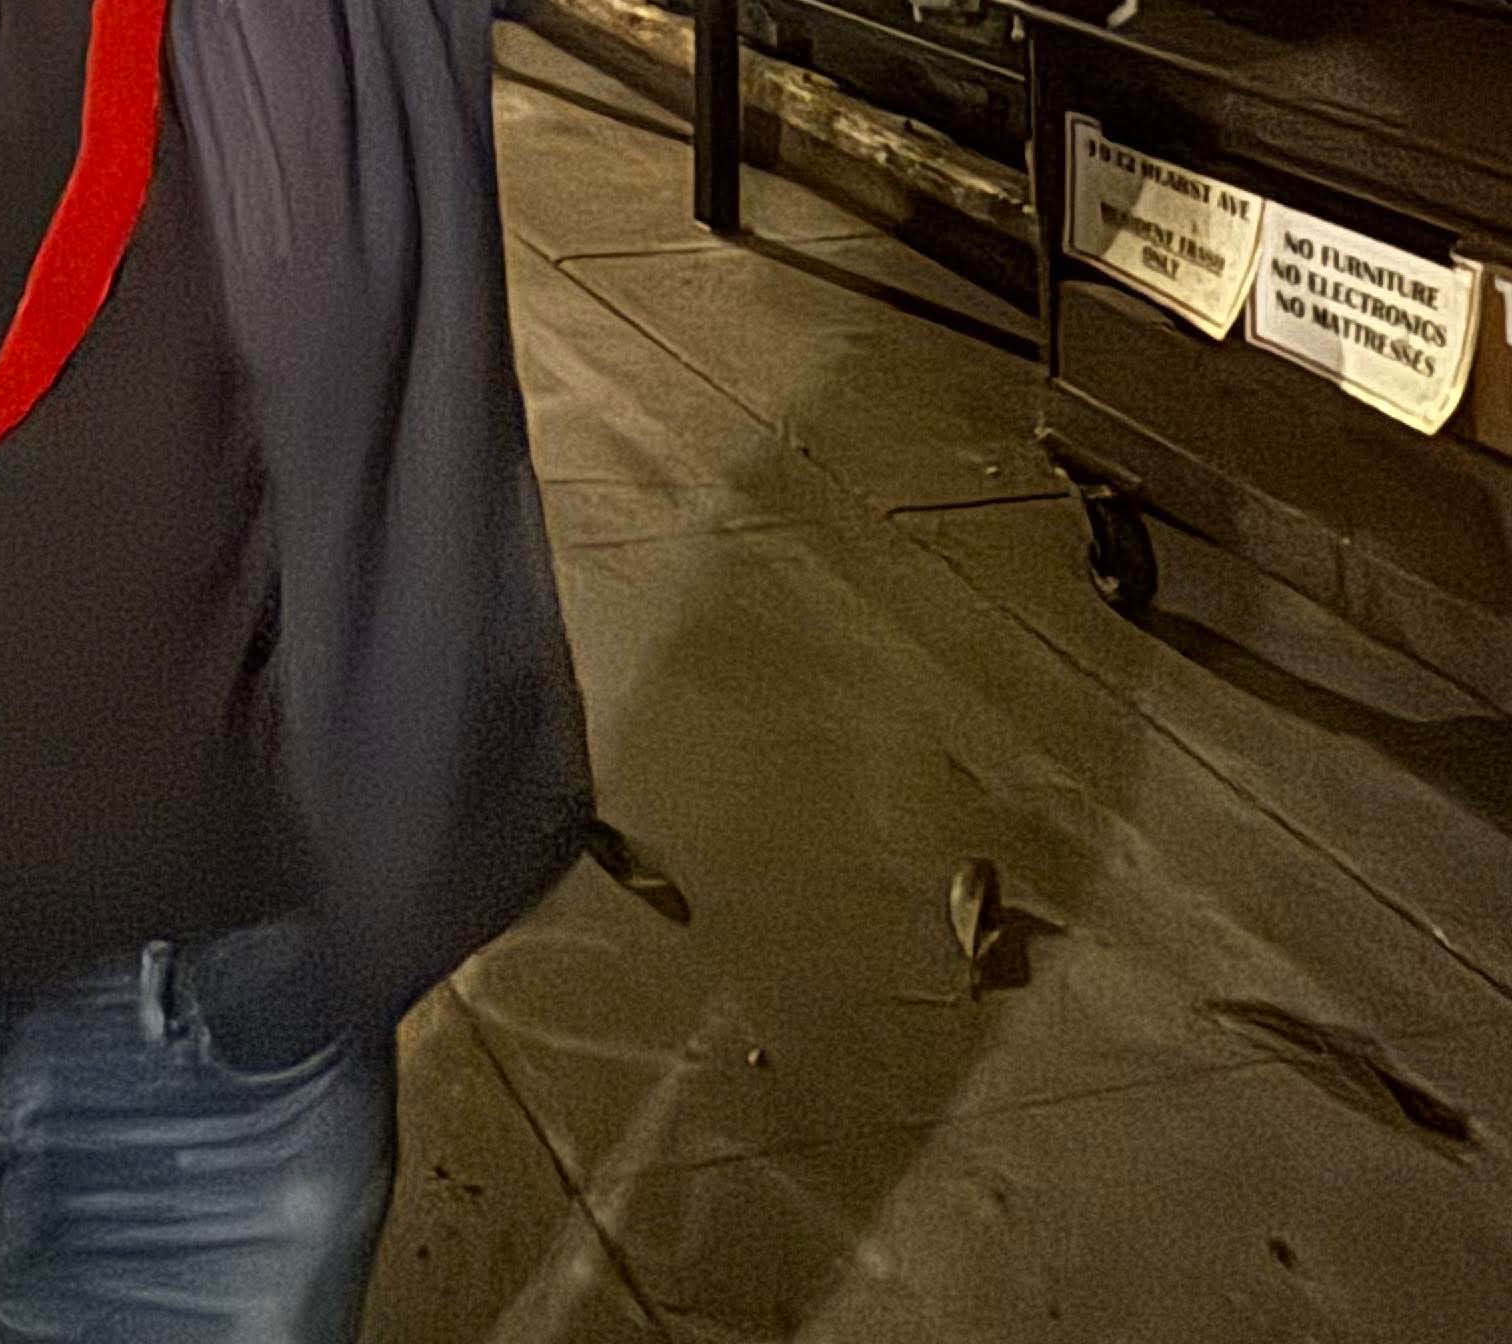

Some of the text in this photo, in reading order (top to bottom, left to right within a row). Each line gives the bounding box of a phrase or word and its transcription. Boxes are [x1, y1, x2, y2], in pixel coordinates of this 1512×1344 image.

[1271, 257, 1301, 286] NO
[1307, 270, 1447, 348] ELECTRONICS
[1284, 230, 1441, 310] NO FURNITURE
[1276, 290, 1305, 318] NO
[1312, 304, 1436, 378] MATTRESSES
